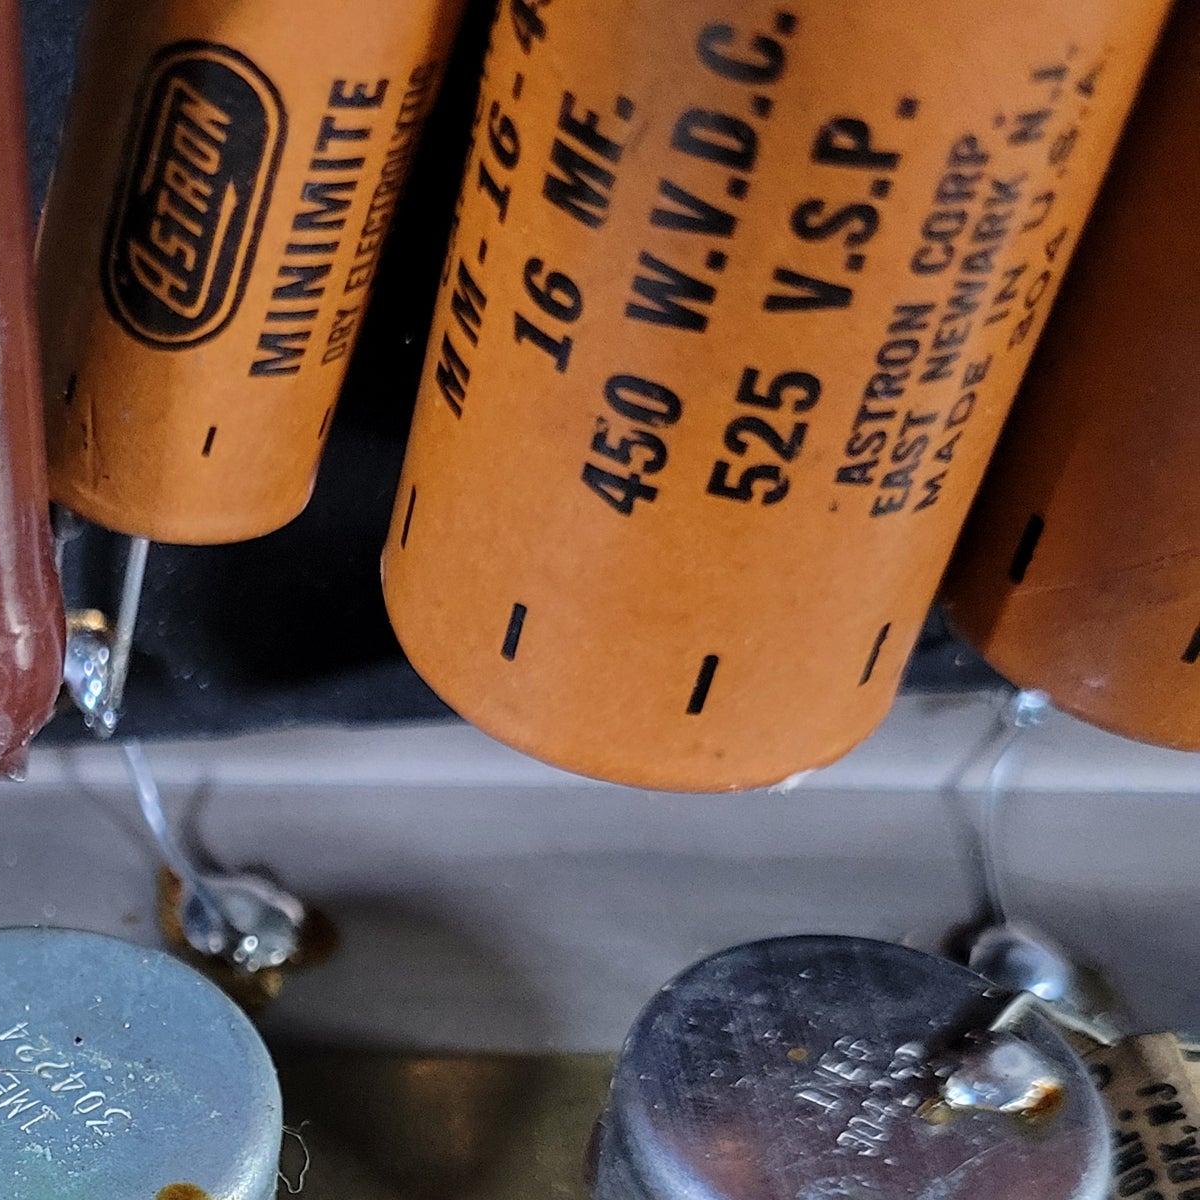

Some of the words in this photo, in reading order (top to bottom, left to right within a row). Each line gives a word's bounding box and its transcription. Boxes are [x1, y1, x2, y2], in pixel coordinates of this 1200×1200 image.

[128, 76, 237, 320] ASTRON
[248, 78, 390, 378] MINIMITE
[435, 0, 551, 420] MM-16-4
[541, 90, 636, 229] MF.
[624, 11, 798, 334] W.V.D.C.
[762, 96, 920, 312] V.S.P.
[321, 302, 362, 367] DRY
[513, 256, 584, 375] 16
[834, 301, 936, 487] ASTRON
[869, 406, 940, 519] EAST
[918, 171, 1027, 386] NEWARK
[912, 353, 993, 513] MADE
[984, 262, 1028, 327] IN
[580, 373, 683, 517] 450
[706, 366, 822, 505] 525
